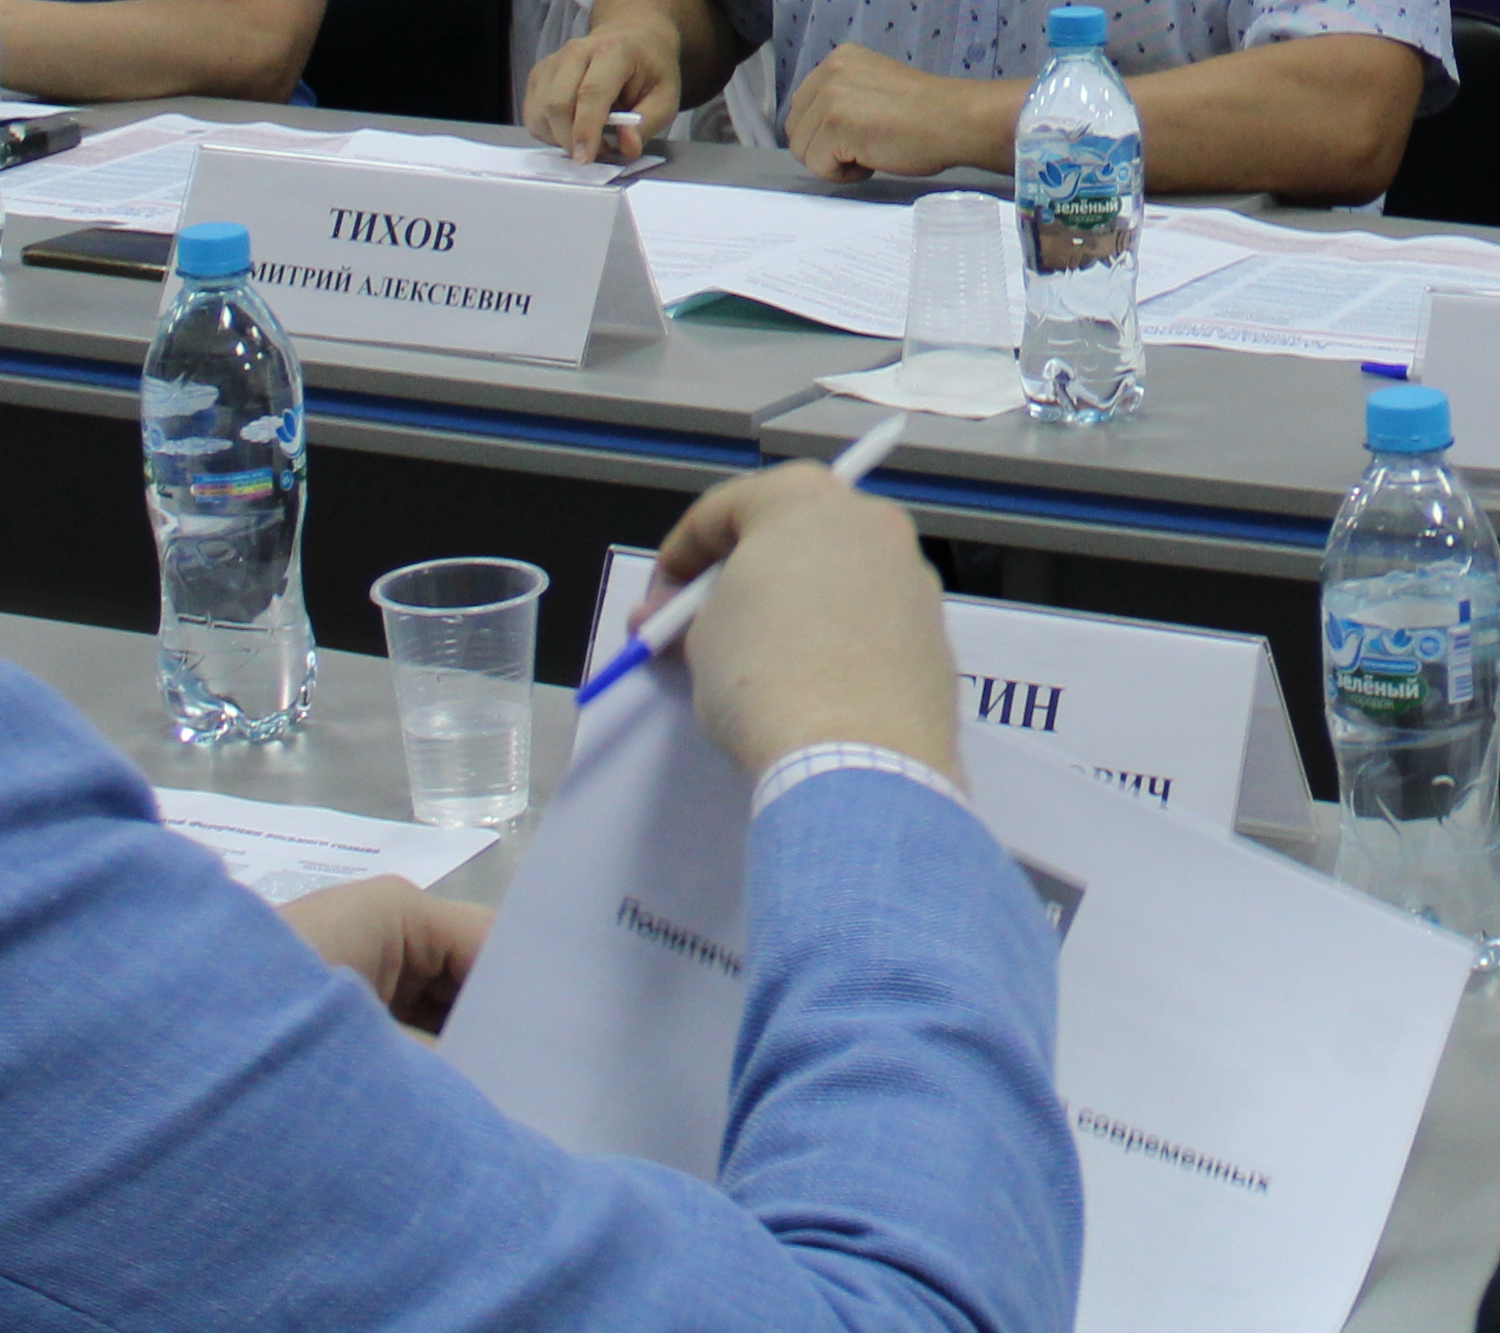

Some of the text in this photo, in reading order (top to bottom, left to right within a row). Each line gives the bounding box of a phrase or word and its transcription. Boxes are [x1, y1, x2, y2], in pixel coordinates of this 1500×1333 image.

[329, 206, 457, 254] ТИХОВ
[248, 258, 534, 318] МИТРИЙ АЛЕКСЕЕВИЧ
[1076, 1106, 1274, 1195] современных
